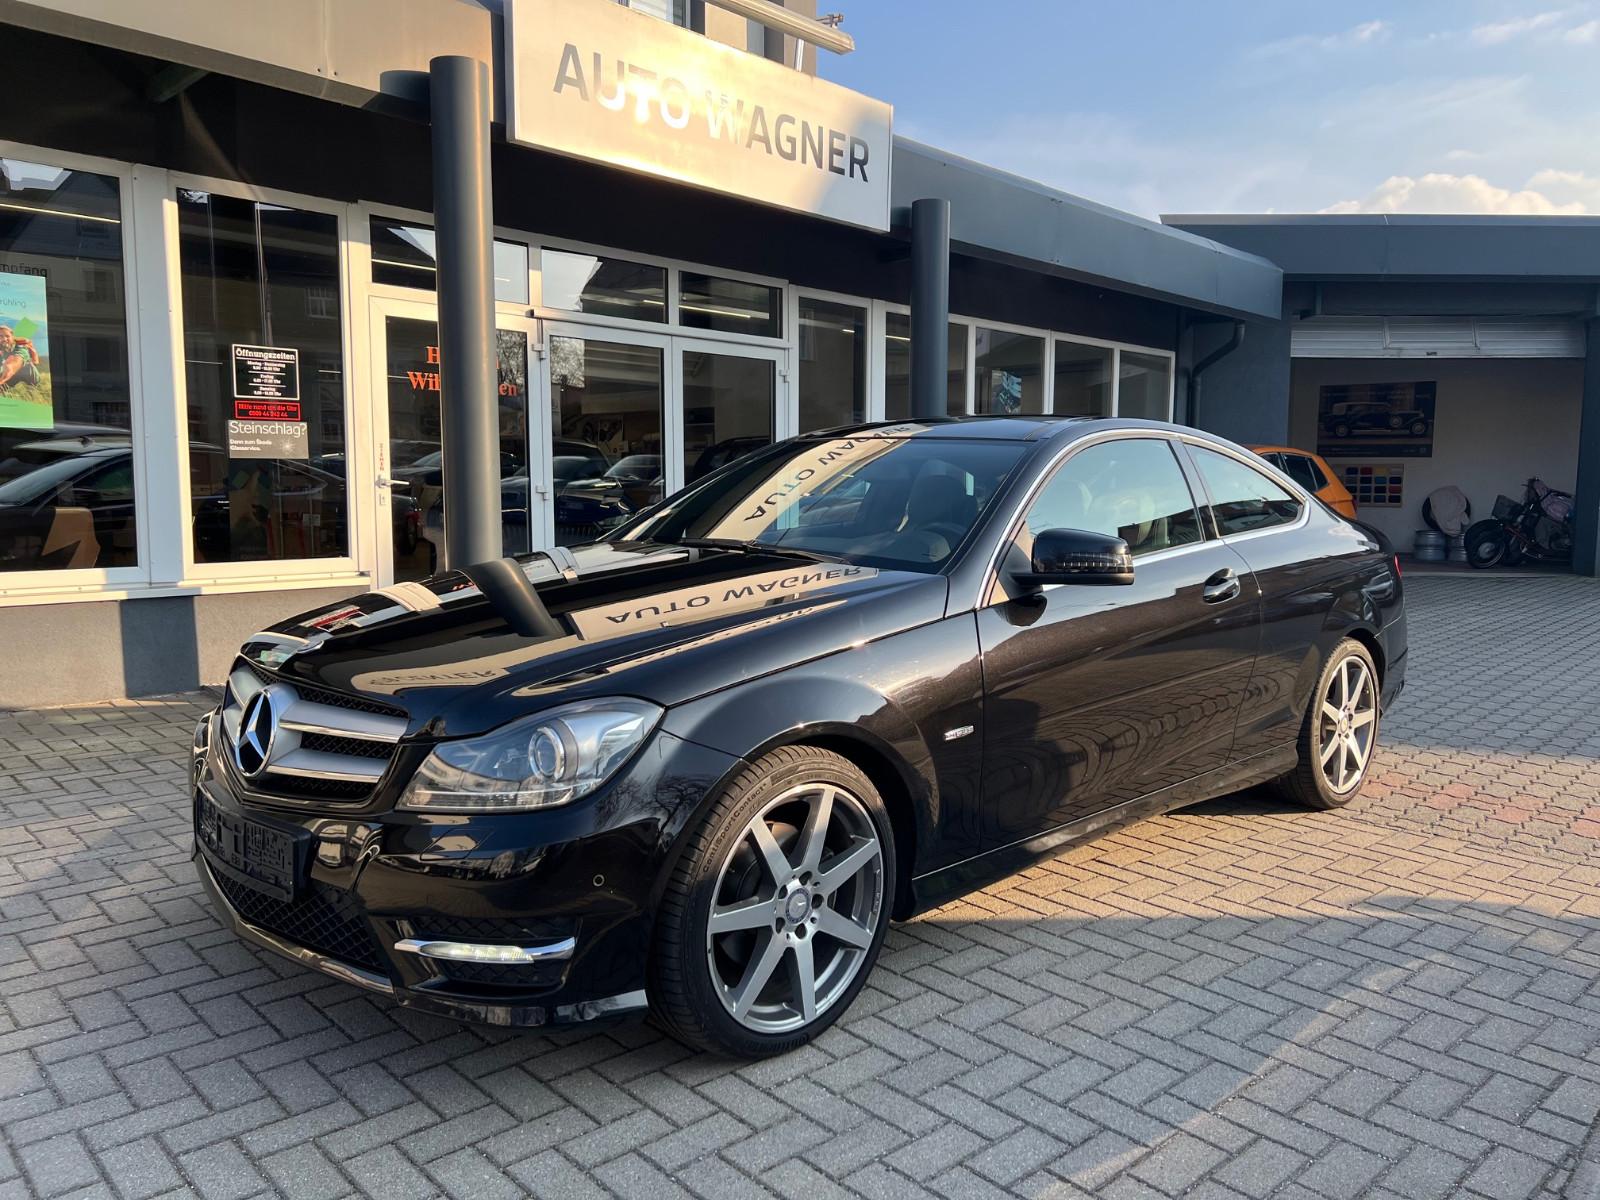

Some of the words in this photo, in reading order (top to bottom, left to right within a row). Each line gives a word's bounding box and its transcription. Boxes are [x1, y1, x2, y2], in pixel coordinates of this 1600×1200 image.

[553, 43, 690, 130] AUTO
[705, 90, 869, 183] WAGNER
[236, 347, 296, 360] Öffnungszeiten
[230, 420, 307, 438] Steinschlag?
